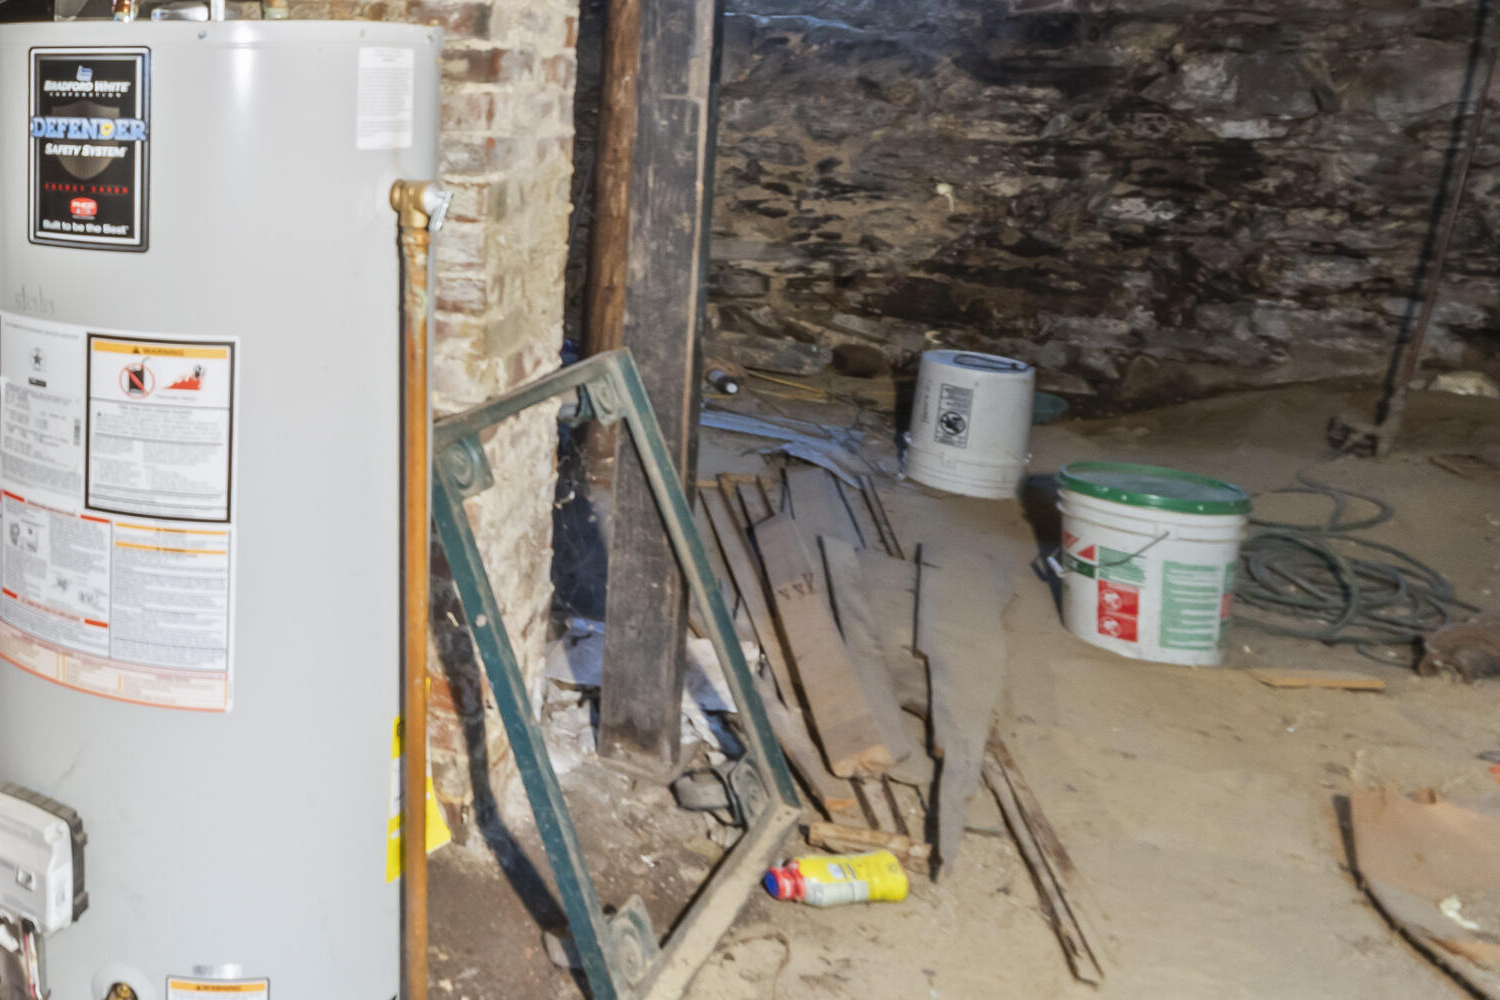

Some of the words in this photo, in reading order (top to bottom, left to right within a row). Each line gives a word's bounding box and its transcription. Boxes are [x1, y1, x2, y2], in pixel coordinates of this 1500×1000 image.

[43, 80, 94, 92] BRADFORD
[94, 80, 131, 93] WHITE
[32, 116, 148, 142] DEFENDER
[44, 142, 81, 156] SAFETY
